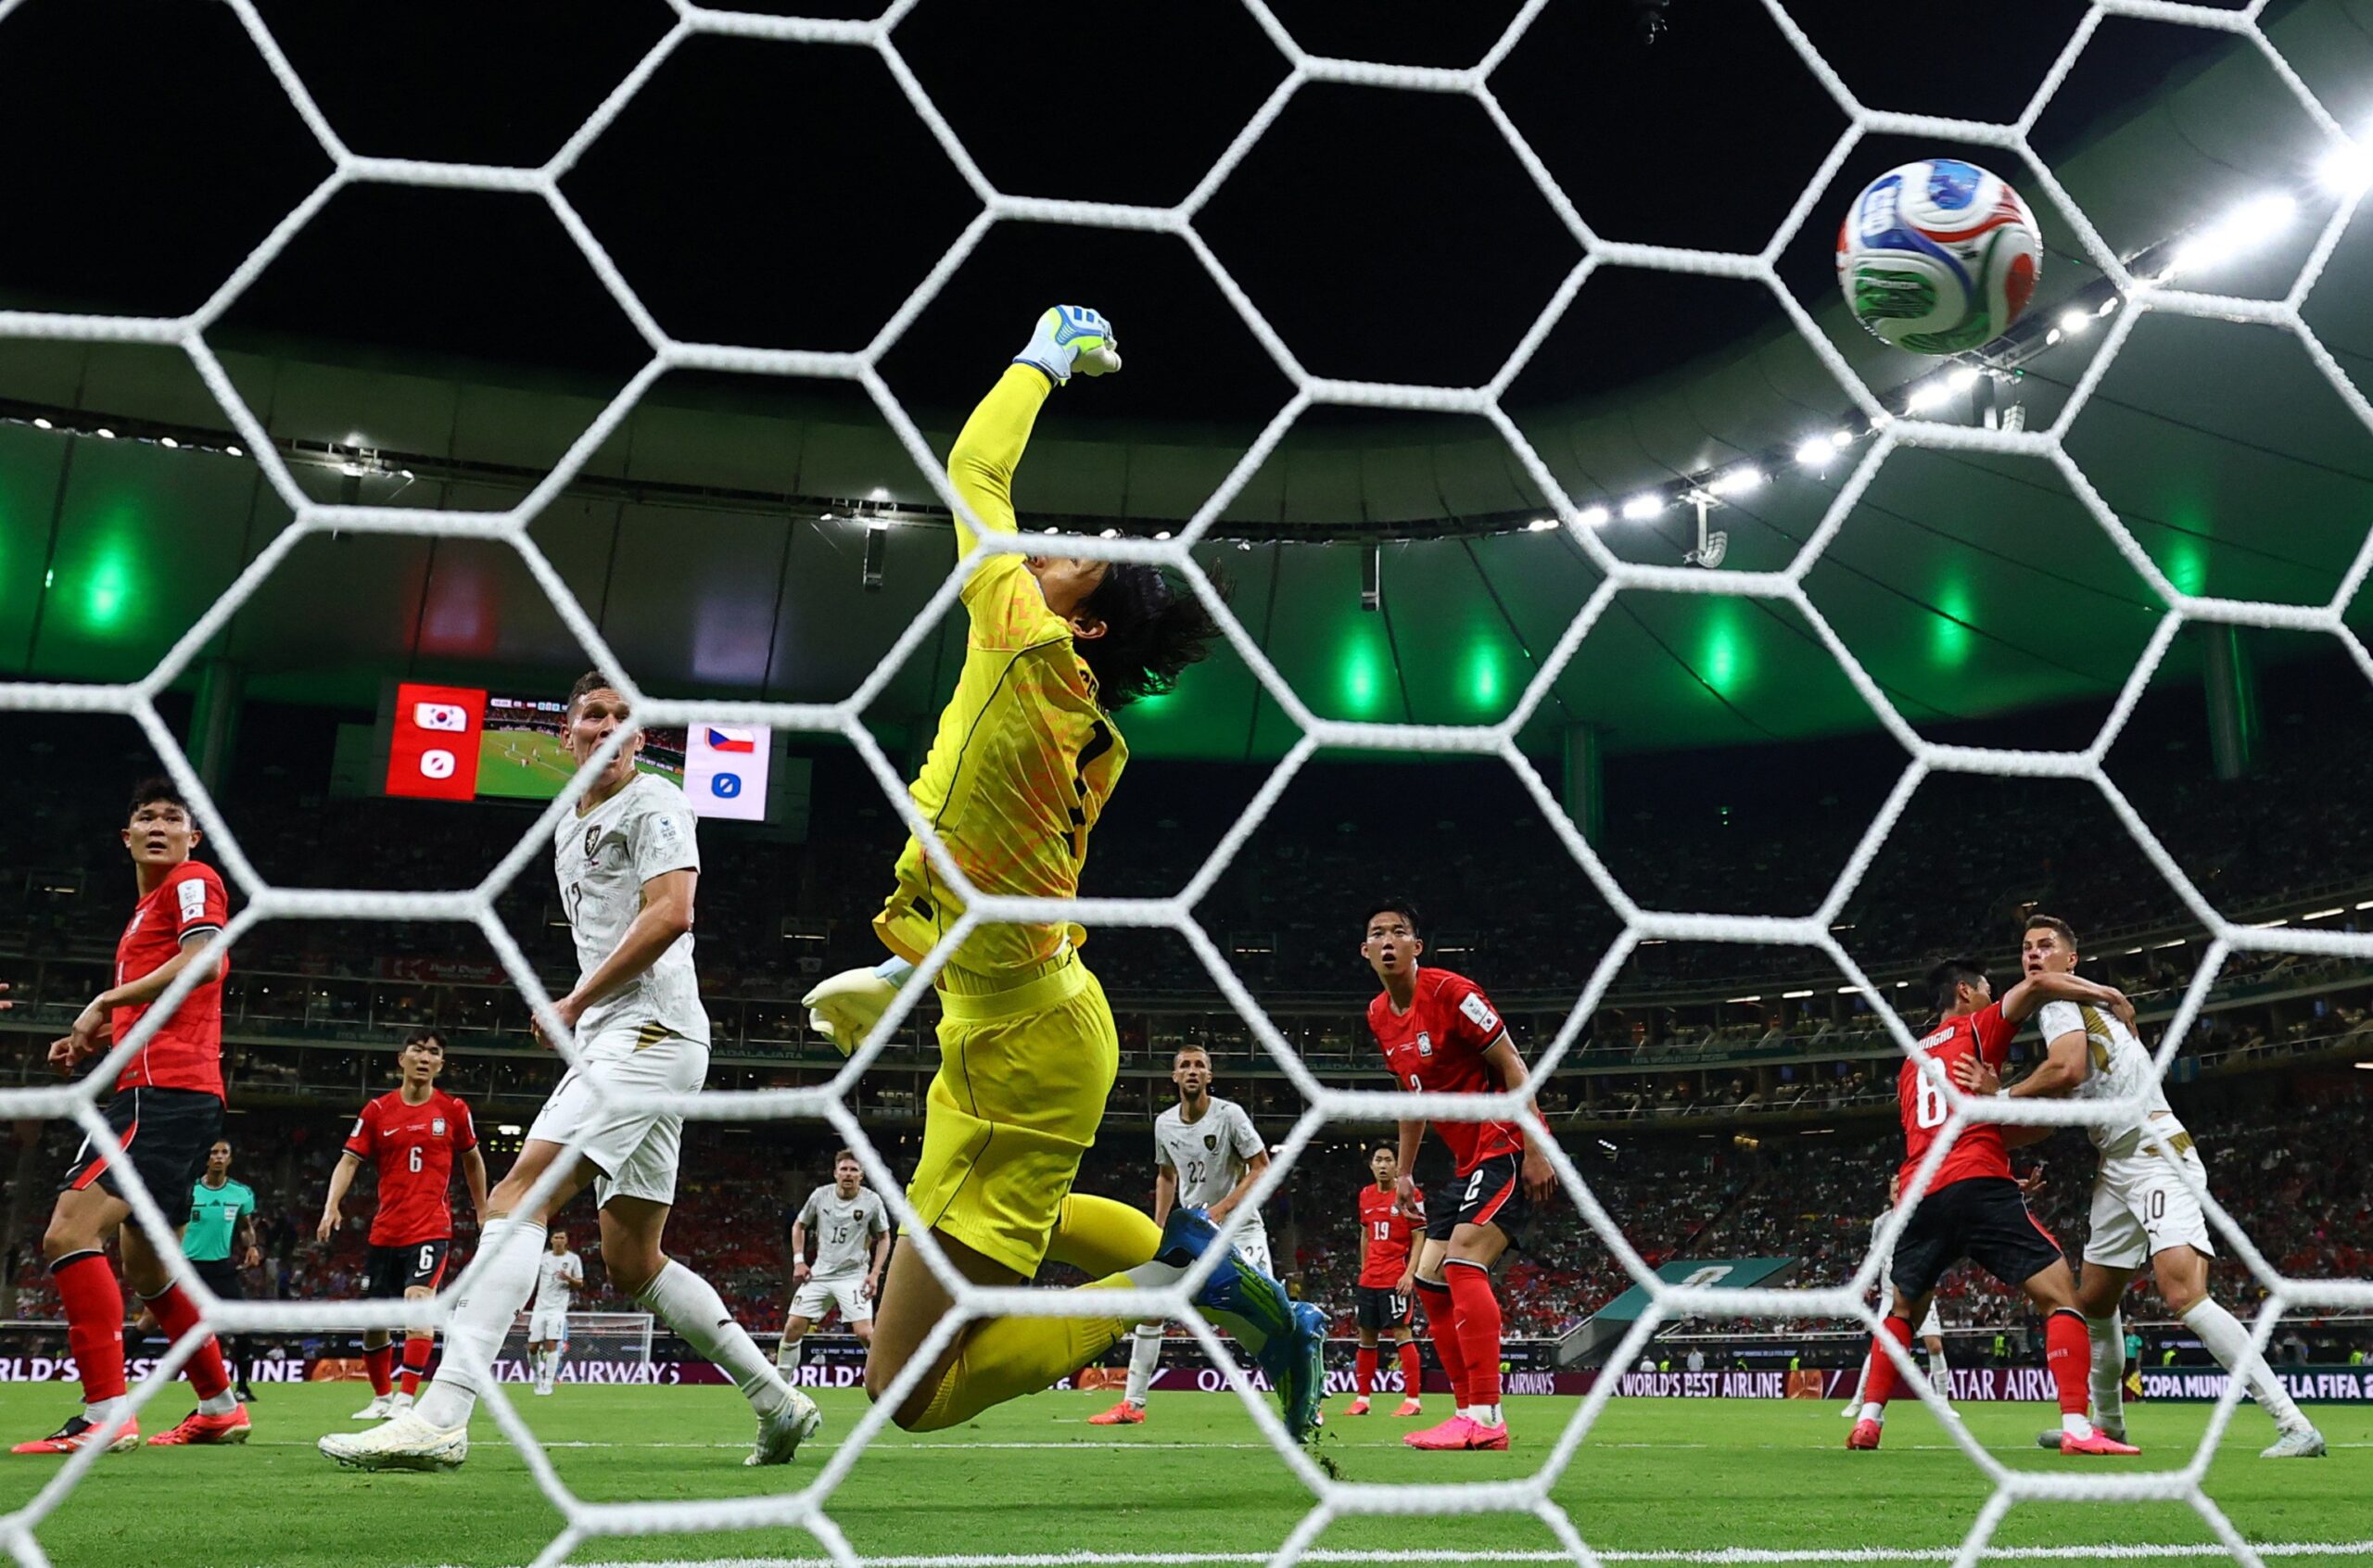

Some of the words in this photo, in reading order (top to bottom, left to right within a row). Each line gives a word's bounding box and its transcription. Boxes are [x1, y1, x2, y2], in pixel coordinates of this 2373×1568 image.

[1915, 1026, 1956, 1051] UNGHO
[1916, 1057, 1948, 1129] 8
[409, 1146, 423, 1173] 6
[1187, 1160, 1206, 1183] 22
[1465, 1170, 1484, 1202] 2
[2142, 1189, 2165, 1225] 10
[831, 1226, 848, 1245] 15
[1374, 1221, 1390, 1241] 19
[419, 1245, 435, 1271] 6
[1390, 1295, 1407, 1314] 19
[1197, 1370, 1275, 1393] QATA
[1507, 1372, 1555, 1396] AIRWAYS
[1623, 1373, 1681, 1397] WORLD'S
[1683, 1372, 1719, 1397] BEST
[1721, 1372, 1784, 1399] AIRLINE
[1944, 1368, 1997, 1400] ATAR
[2141, 1375, 2184, 1397] COPA
[2290, 1373, 2317, 1398] LA
[2317, 1373, 2363, 1399] FIFA
